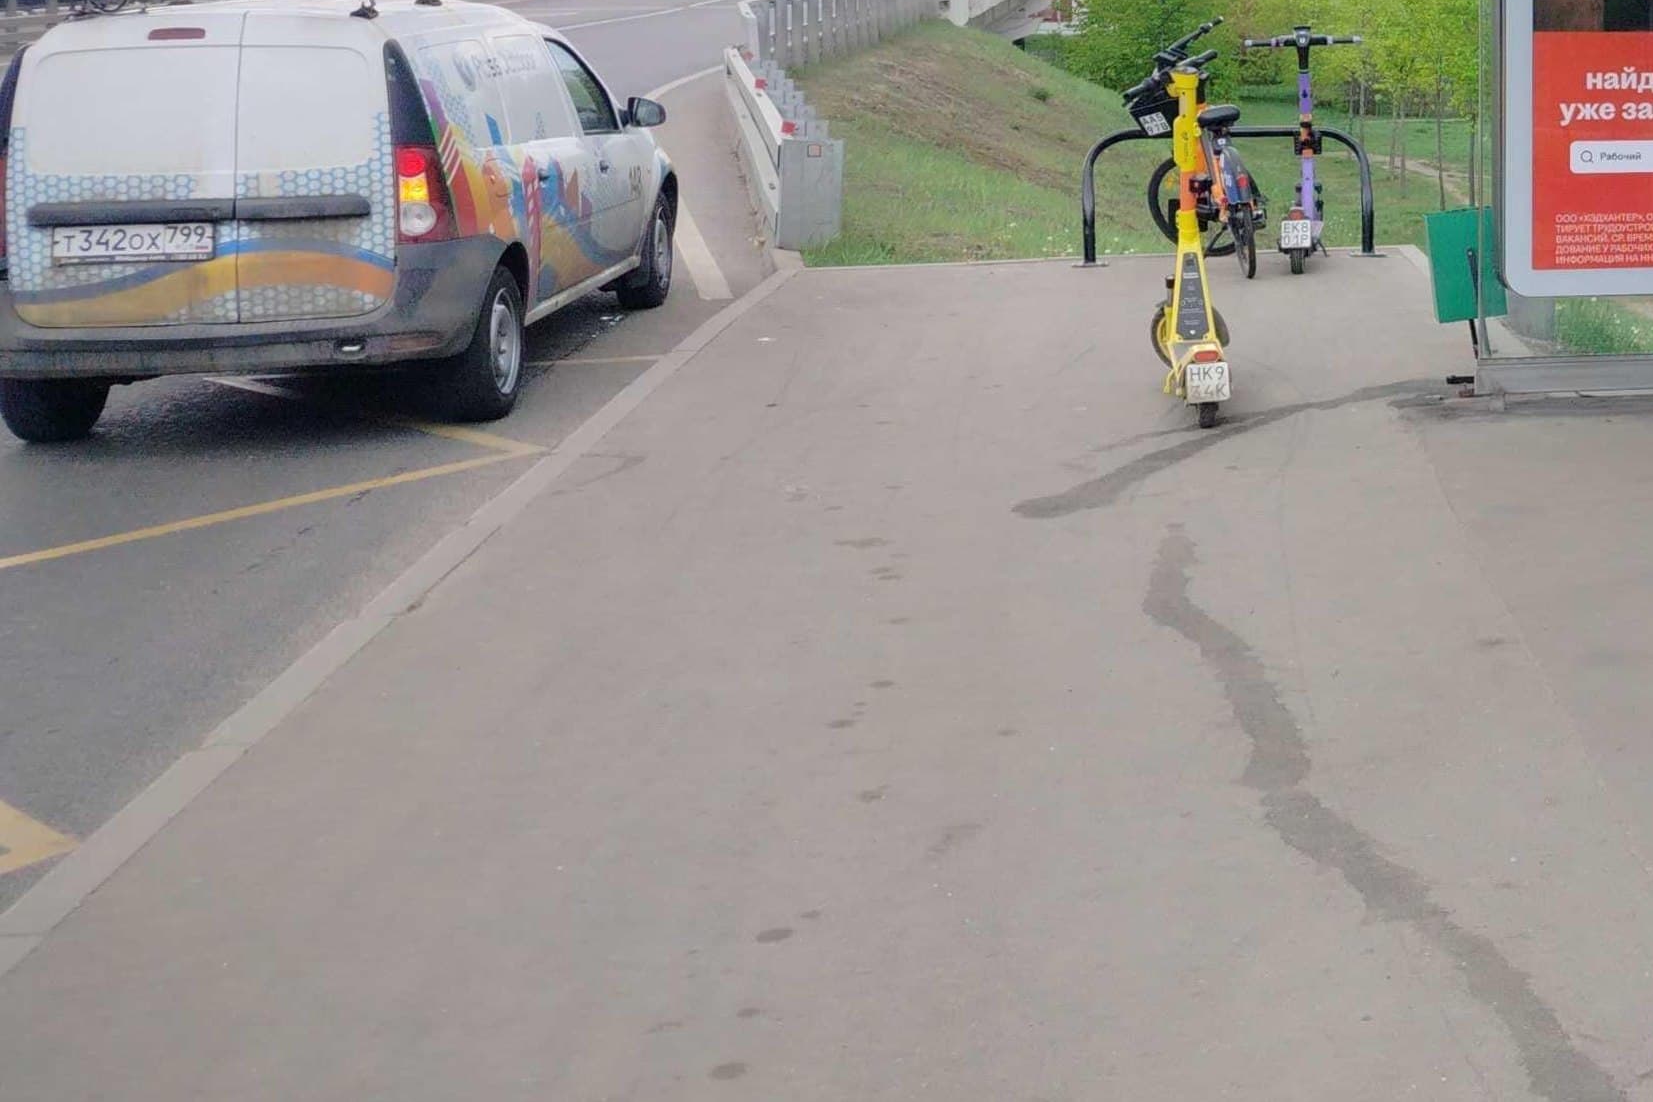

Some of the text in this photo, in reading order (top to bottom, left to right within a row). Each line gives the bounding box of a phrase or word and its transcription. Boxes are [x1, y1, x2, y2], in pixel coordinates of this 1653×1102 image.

[1559, 102, 1616, 126] уже
[1600, 151, 1642, 161] Рабочий
[166, 225, 206, 244] 799
[1625, 253, 1639, 262] НА
